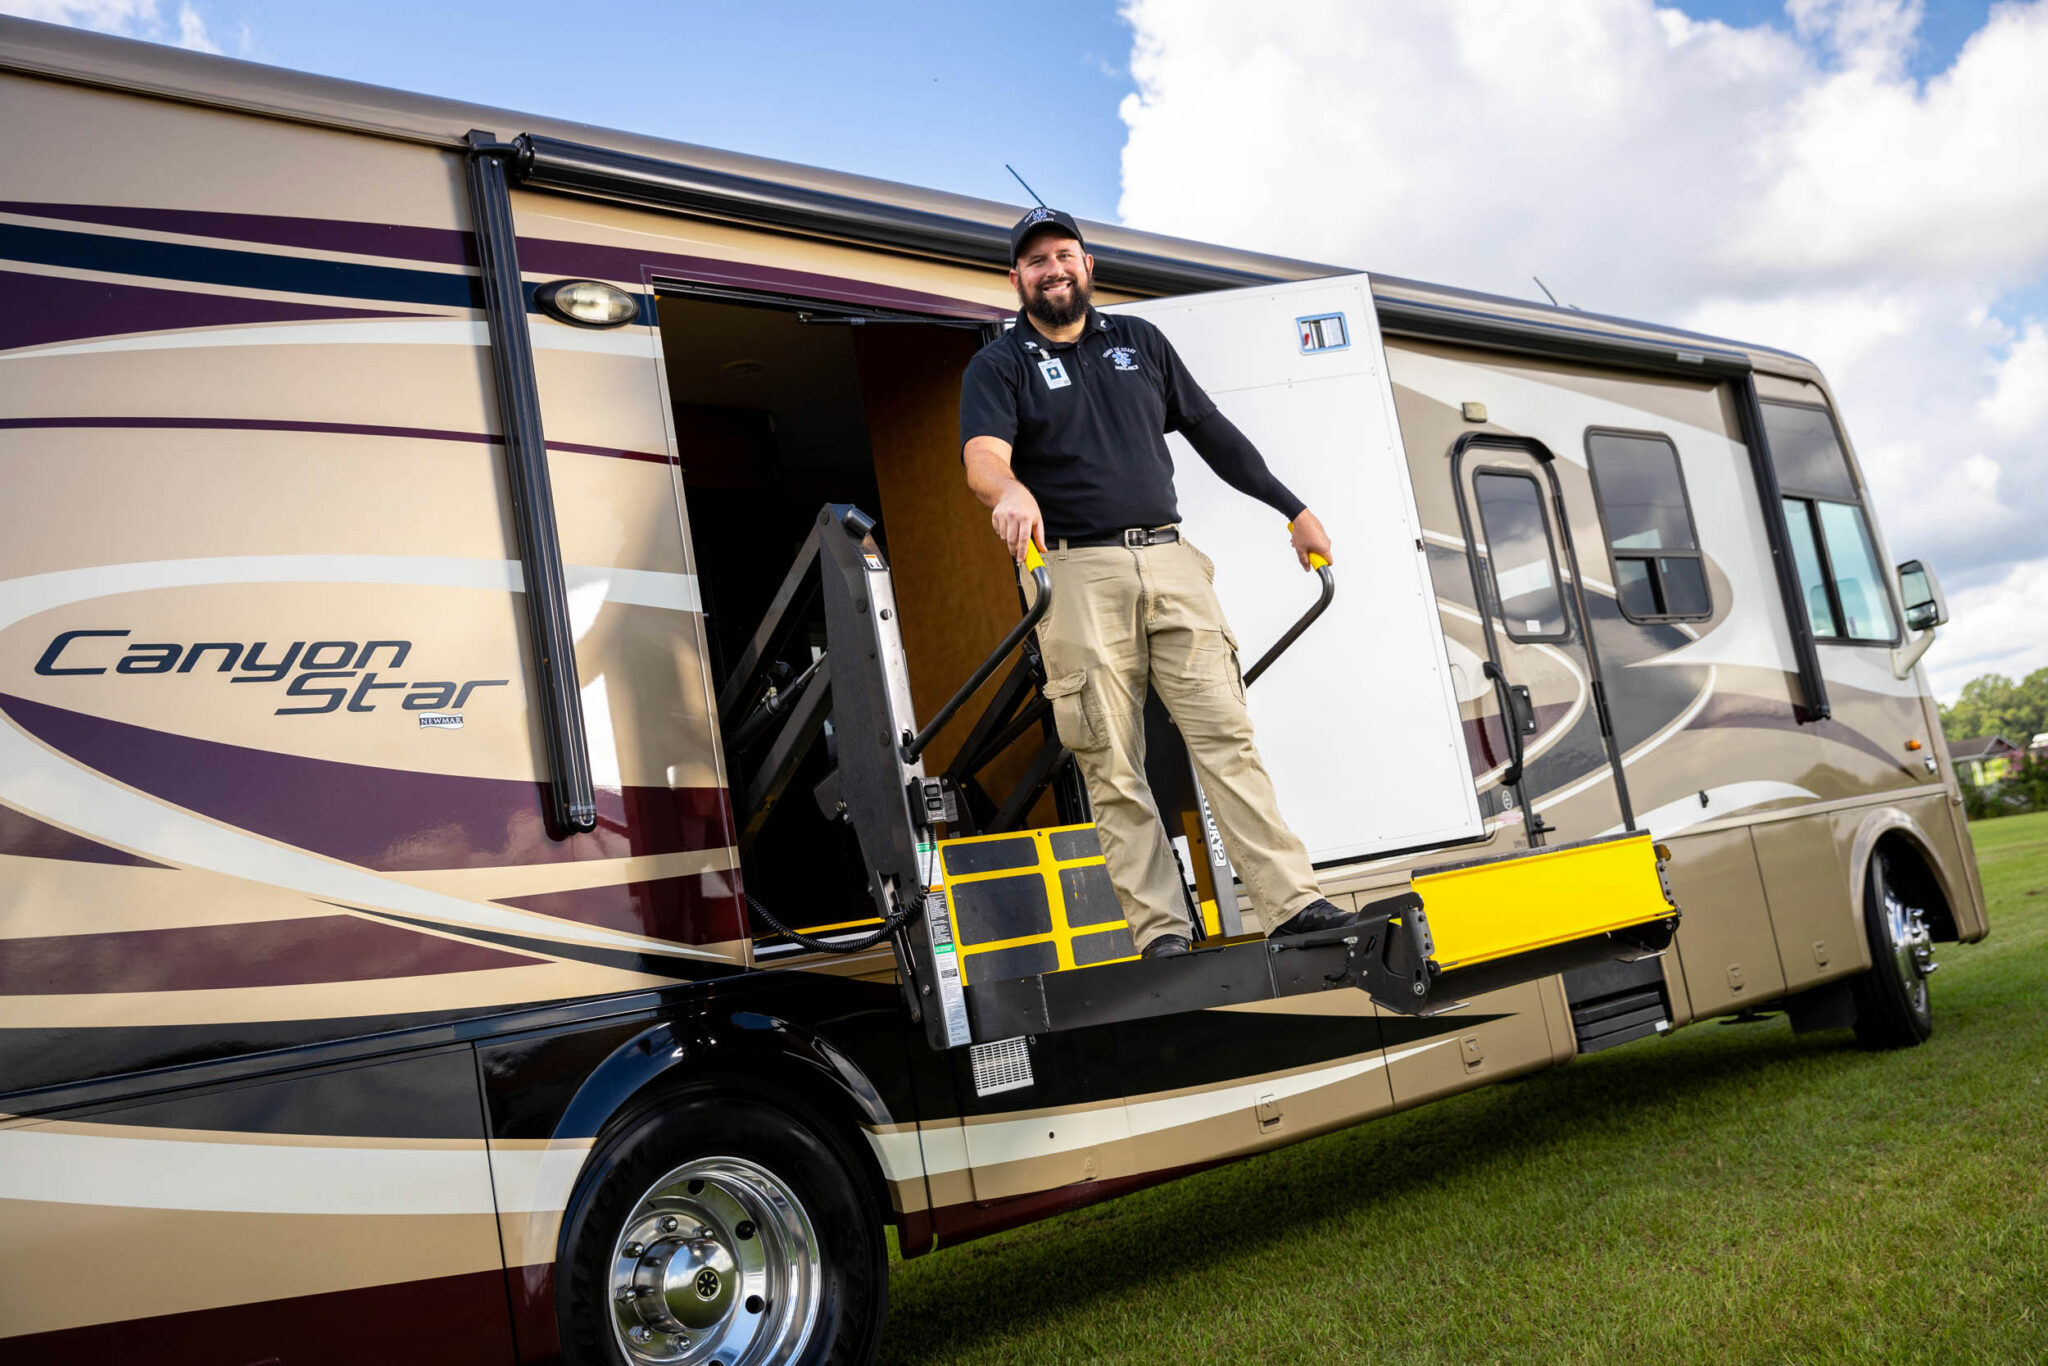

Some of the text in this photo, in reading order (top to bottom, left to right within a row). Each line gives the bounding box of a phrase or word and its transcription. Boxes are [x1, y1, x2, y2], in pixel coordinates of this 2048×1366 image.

[34, 630, 412, 684] Canyon
[274, 671, 509, 716] Star
[420, 716, 463, 726] NEWMAR
